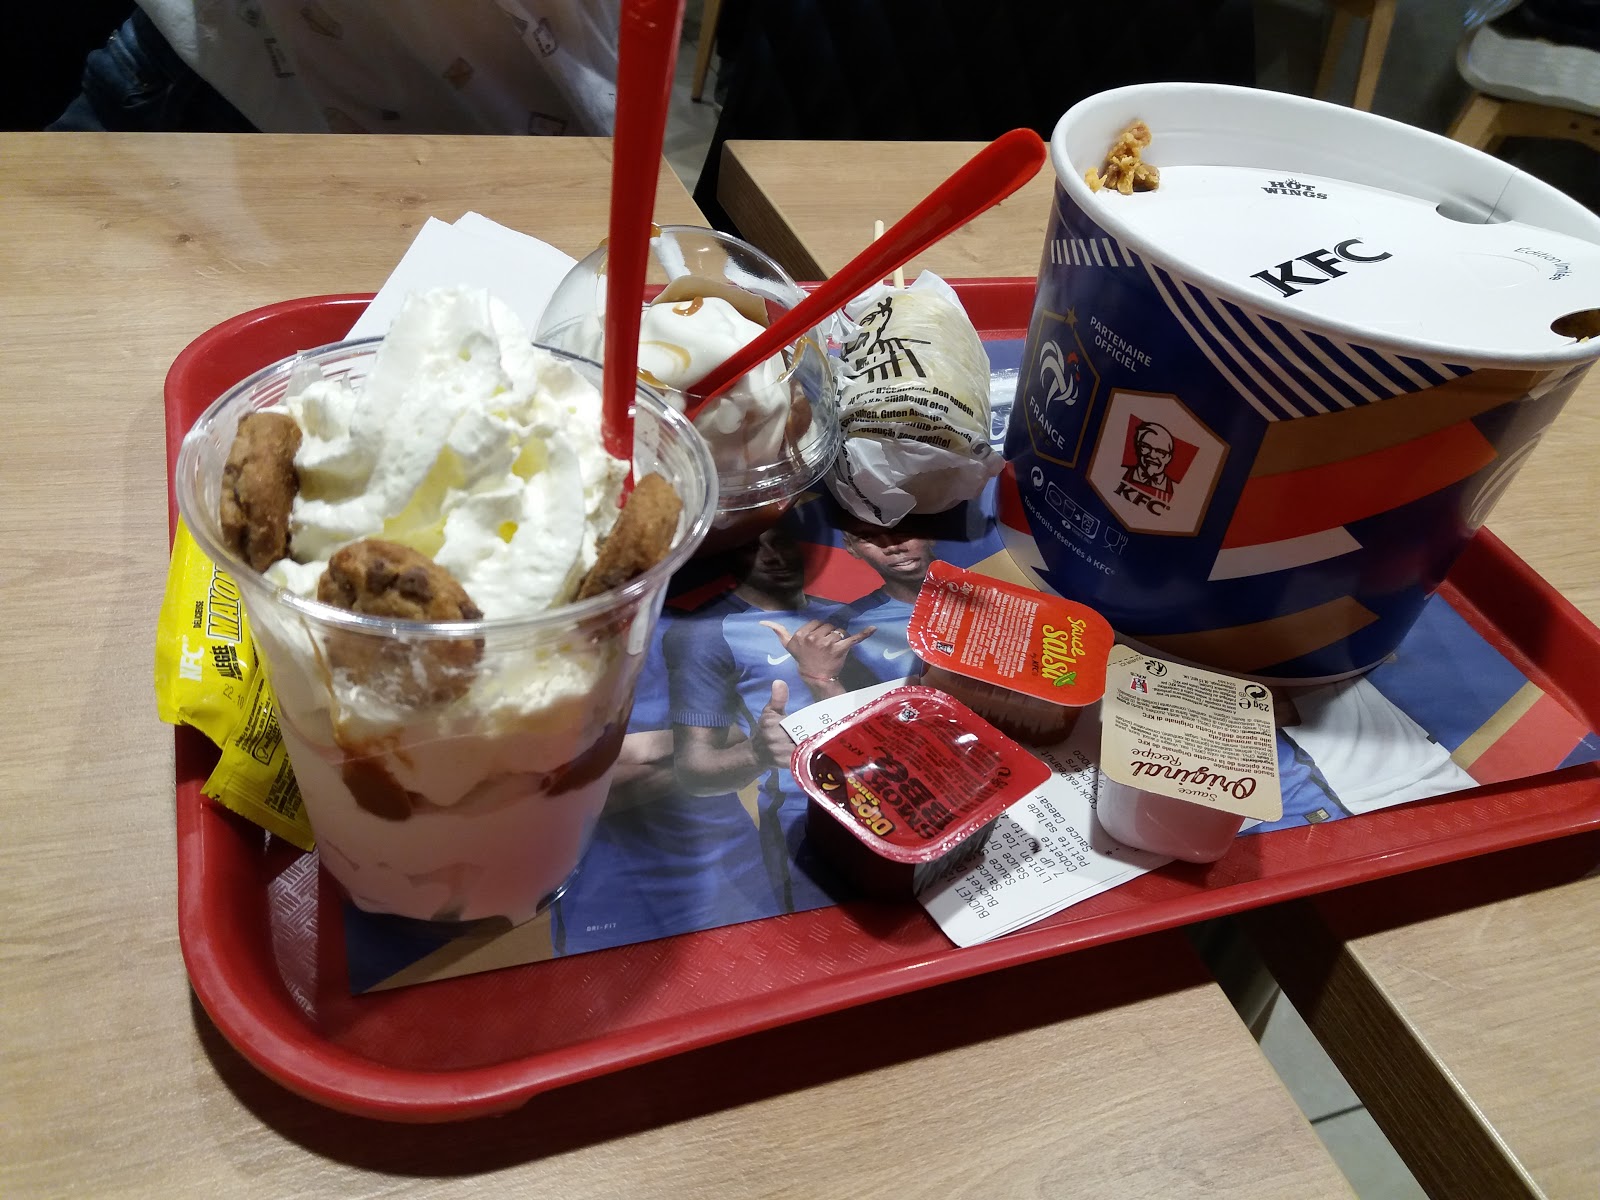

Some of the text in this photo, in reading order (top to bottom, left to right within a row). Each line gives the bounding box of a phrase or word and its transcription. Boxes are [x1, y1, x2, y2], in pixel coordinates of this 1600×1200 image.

[1261, 187, 1328, 199] WINGS
[1268, 179, 1315, 191] HOT
[1249, 238, 1393, 298] KFC
[1090, 316, 1152, 367] PARTENAIRE
[1094, 334, 1137, 373] OFFICIEL
[932, 386, 949, 400] Bon
[880, 409, 908, 419] Guten
[1029, 396, 1066, 450] FRANCE
[1113, 481, 1166, 516] KFC
[1036, 511, 1053, 532] droits
[1053, 529, 1086, 559] réservés
[1086, 553, 1093, 563] à
[210, 645, 237, 679] ALLÉGÉE
[1252, 700, 1270, 713] 23g
[1073, 750, 1098, 774] Choco
[1130, 748, 1181, 767] Recipe
[1253, 769, 1275, 777] Sauce
[847, 777, 881, 806] sauce
[873, 745, 959, 832] BBQ
[1128, 759, 1258, 802] Original
[1177, 787, 1218, 802] Sauce
[847, 765, 937, 840] SMOKY
[850, 793, 896, 837] Dips
[1010, 822, 1043, 855] Mojito
[1027, 803, 1091, 867] Petite salade
[1034, 795, 1093, 853] Sauce Caesar
[1002, 832, 1052, 884] Lipton Ice
[1002, 852, 1029, 880] Sauce
[1039, 856, 1056, 869] UP
[1041, 836, 1078, 873] Cobette
[976, 864, 1003, 892] Sauce
[989, 858, 1016, 886] Sauce
[955, 886, 990, 919] BUCKET
[965, 875, 999, 908] Bucket
[586, 922, 617, 932] DRI-FIT
